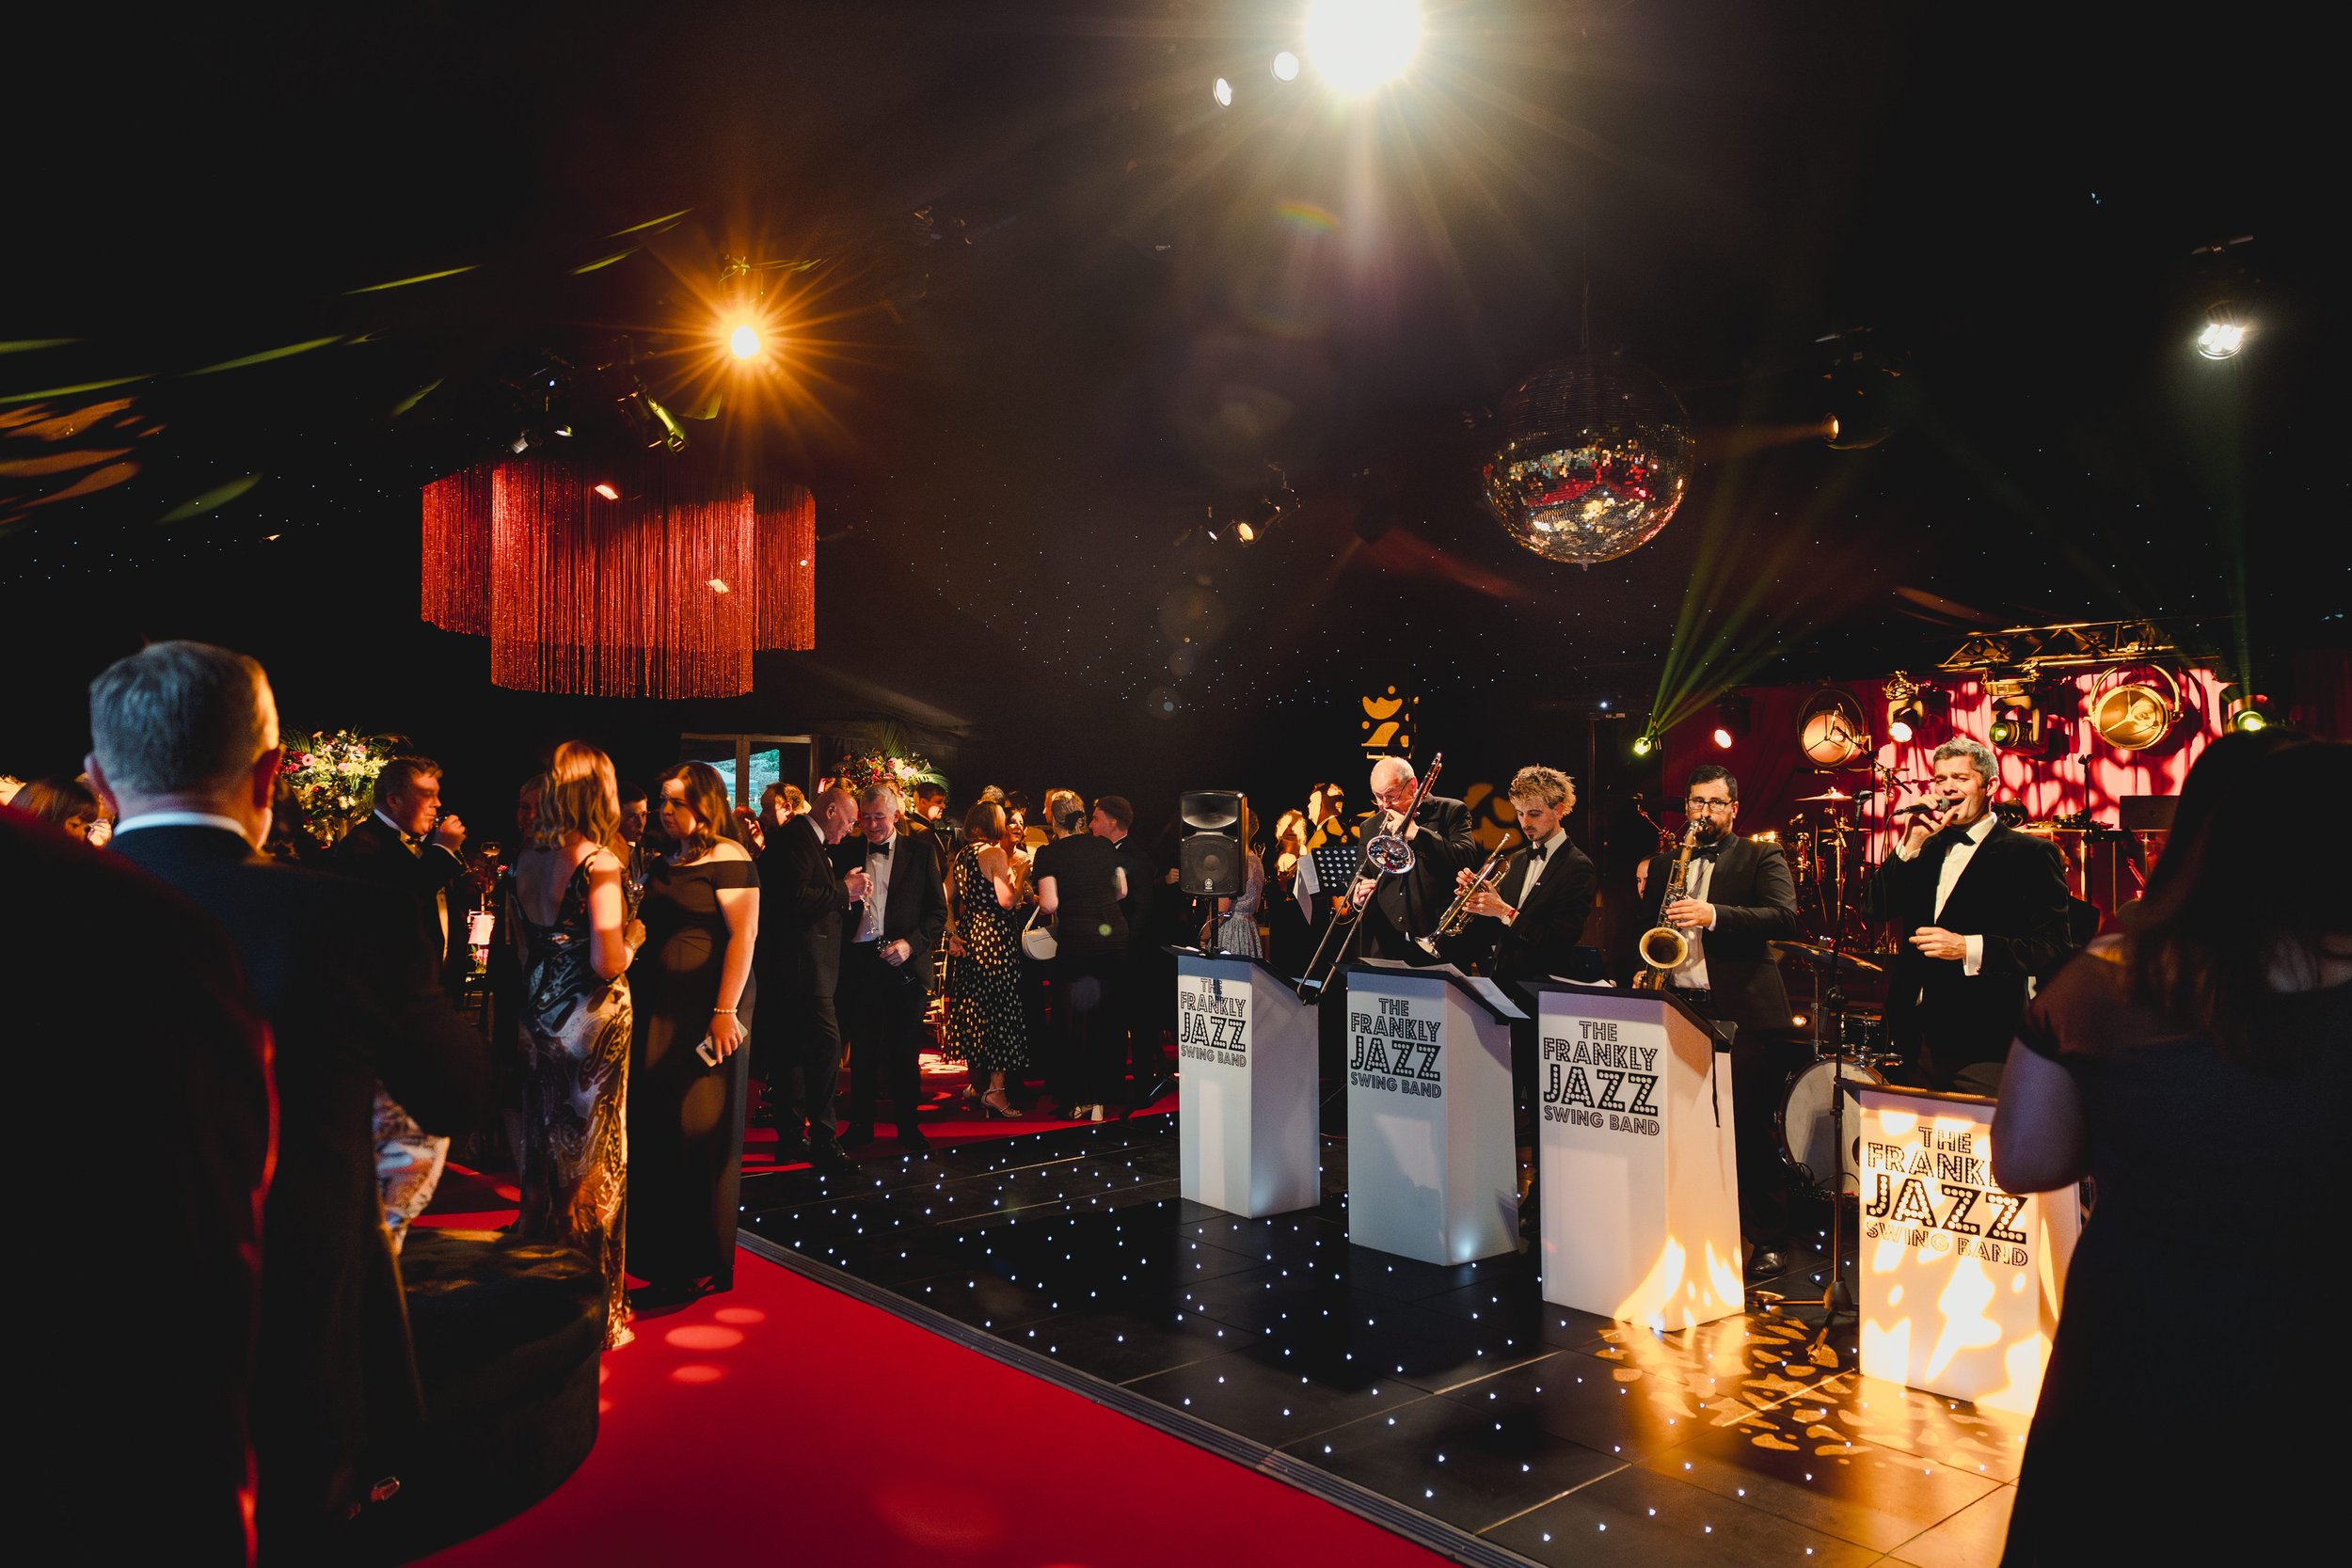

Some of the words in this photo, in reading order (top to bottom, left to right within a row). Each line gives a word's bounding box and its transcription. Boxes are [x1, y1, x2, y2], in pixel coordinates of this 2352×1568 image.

[1200, 978, 1222, 994] THE
[1181, 991, 1247, 1017] FRANKLY
[1378, 998, 1409, 1016] THE
[1181, 1012, 1246, 1053] JAZZ
[1351, 1012, 1441, 1042] FRANKLY
[1579, 1021, 1617, 1041] THE
[1181, 1045, 1215, 1062] SWING
[1217, 1051, 1247, 1068] BAND
[1351, 1036, 1441, 1082] JAZZ
[1544, 1037, 1658, 1070] FRANKLY
[1351, 1071, 1398, 1091] SWING
[1402, 1079, 1441, 1099] BAND
[1543, 1064, 1659, 1117] JAZZ
[1544, 1105, 1603, 1128] SWING
[1610, 1115, 1660, 1135] BAND
[1918, 1126, 1971, 1154] THE
[1867, 1142, 2000, 1188] FRANK
[1866, 1174, 2028, 1244] JAZZ
[1867, 1221, 1950, 1252] SWING
[1958, 1238, 2028, 1266] BAND
